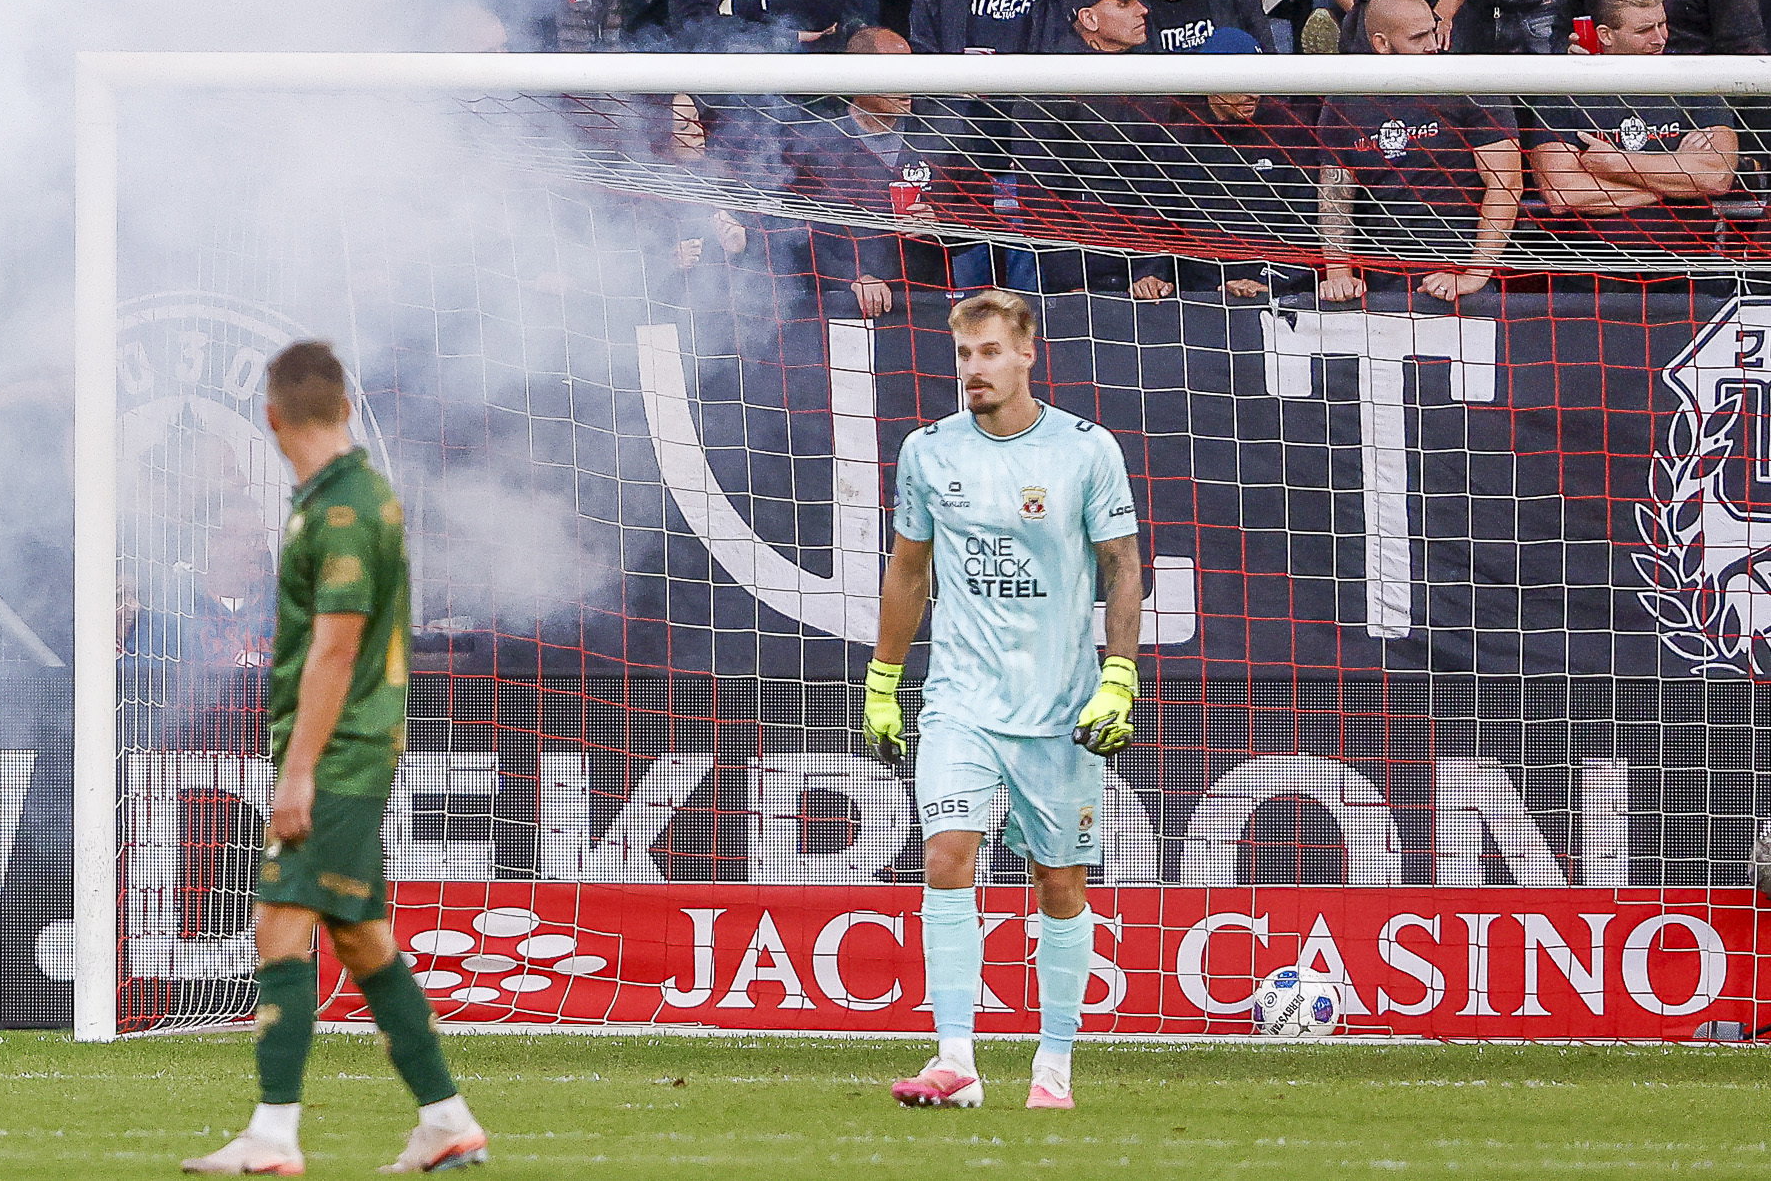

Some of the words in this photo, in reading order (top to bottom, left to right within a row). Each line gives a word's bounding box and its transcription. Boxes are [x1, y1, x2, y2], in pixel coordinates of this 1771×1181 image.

[966, 536, 1014, 557] ONE
[964, 557, 1033, 579] CLICK
[966, 579, 1047, 599] STEEL
[1176, 911, 1727, 1017] CASINO
[1268, 993, 1306, 1036] DERBYSTAR
